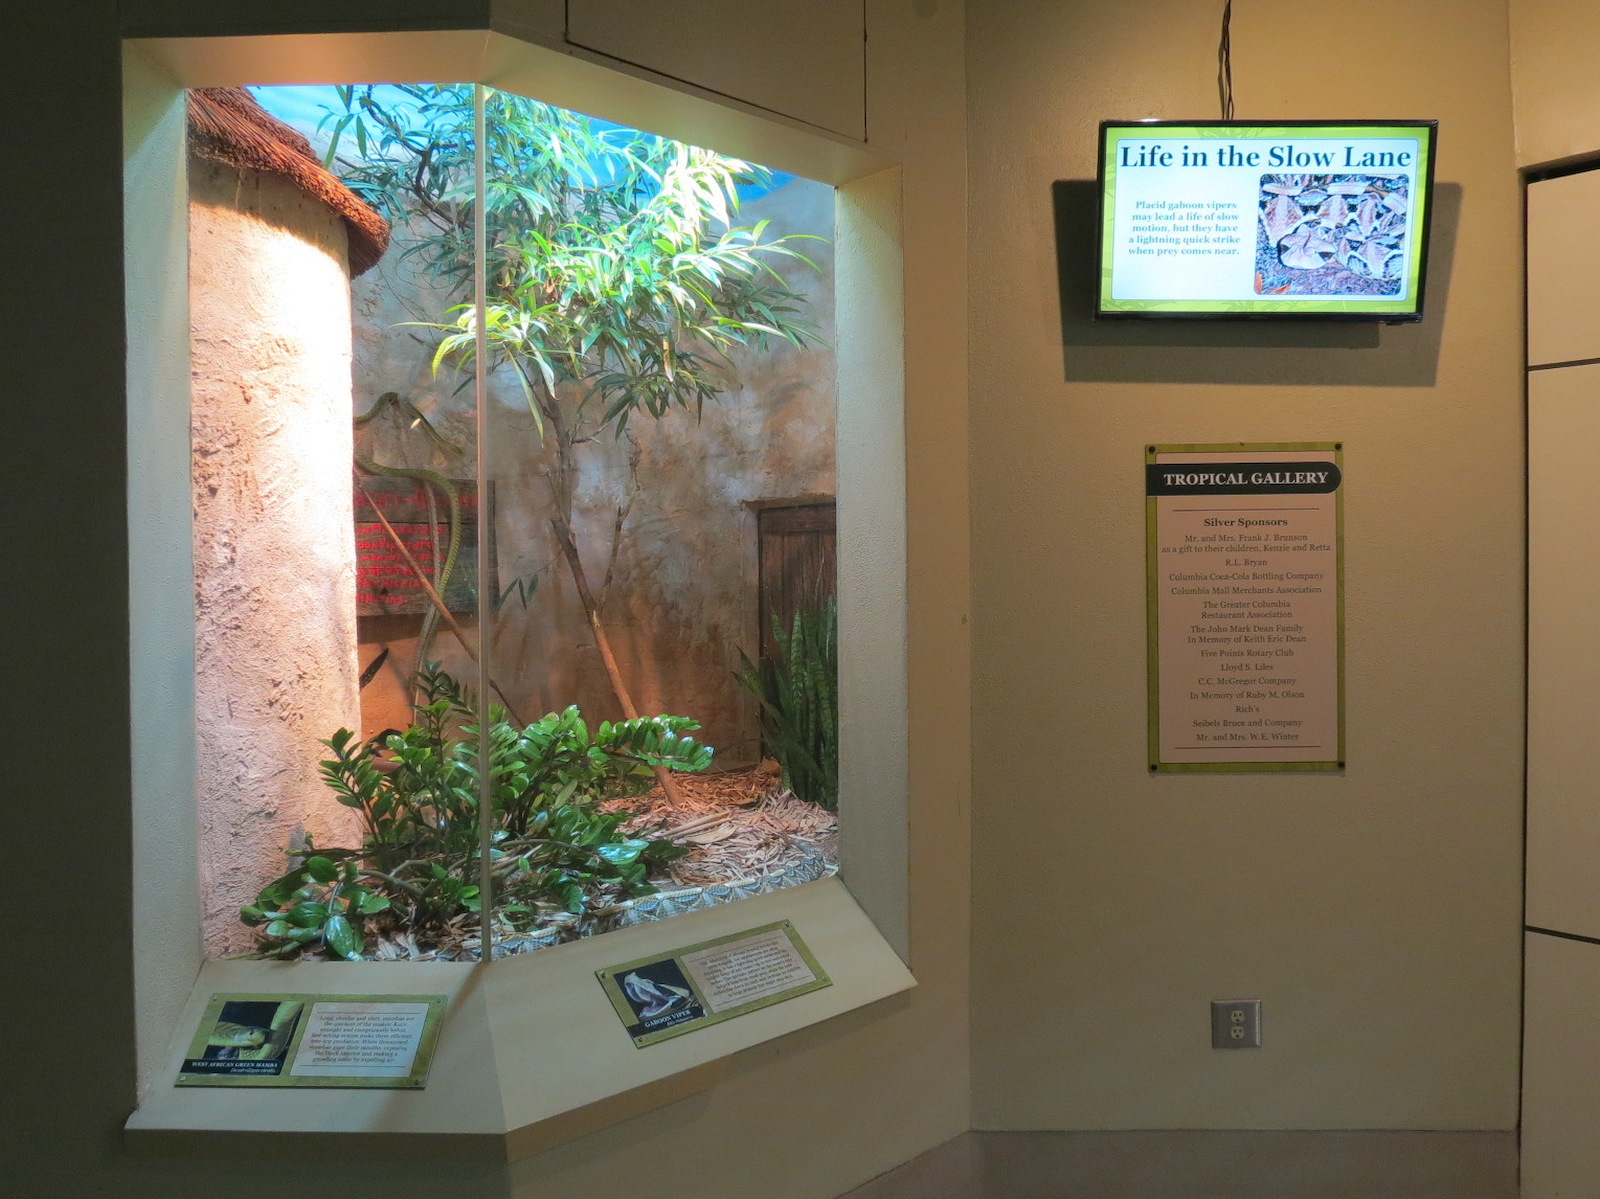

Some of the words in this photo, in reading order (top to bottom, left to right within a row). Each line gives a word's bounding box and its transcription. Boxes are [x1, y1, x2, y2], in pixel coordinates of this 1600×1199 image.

[1122, 146, 1172, 166] Life
[1182, 146, 1207, 166] in
[1218, 146, 1259, 166] the
[1269, 146, 1334, 166] Slow
[1344, 147, 1410, 166] Lane
[1168, 202, 1203, 210] gaboon
[1132, 215, 1152, 224] may
[1155, 212, 1175, 220] lead
[1186, 212, 1202, 220] life
[1204, 212, 1215, 220] of
[1192, 224, 1212, 233] they
[1216, 224, 1238, 232] have
[1137, 235, 1180, 244] lightning
[1183, 236, 1209, 245] quick
[1164, 474, 1248, 485] TROPICAL
[1251, 472, 1328, 484] GALLERY
[1204, 518, 1235, 526] Silver
[1238, 519, 1287, 528] Sponsors
[1179, 545, 1192, 554] gift
[1244, 559, 1267, 567] Bryan
[1169, 573, 1208, 581] Columbia
[1286, 572, 1322, 580] Company
[1252, 600, 1290, 608] Columbia
[1276, 625, 1303, 633] Family
[1199, 636, 1232, 644] Memory
[1247, 650, 1273, 658] Rotary
[1221, 663, 1243, 672] Lloyd
[1258, 678, 1296, 686] Company
[1201, 692, 1234, 701] Memory
[1246, 692, 1266, 700] Ruby
[1264, 719, 1302, 727] Company
